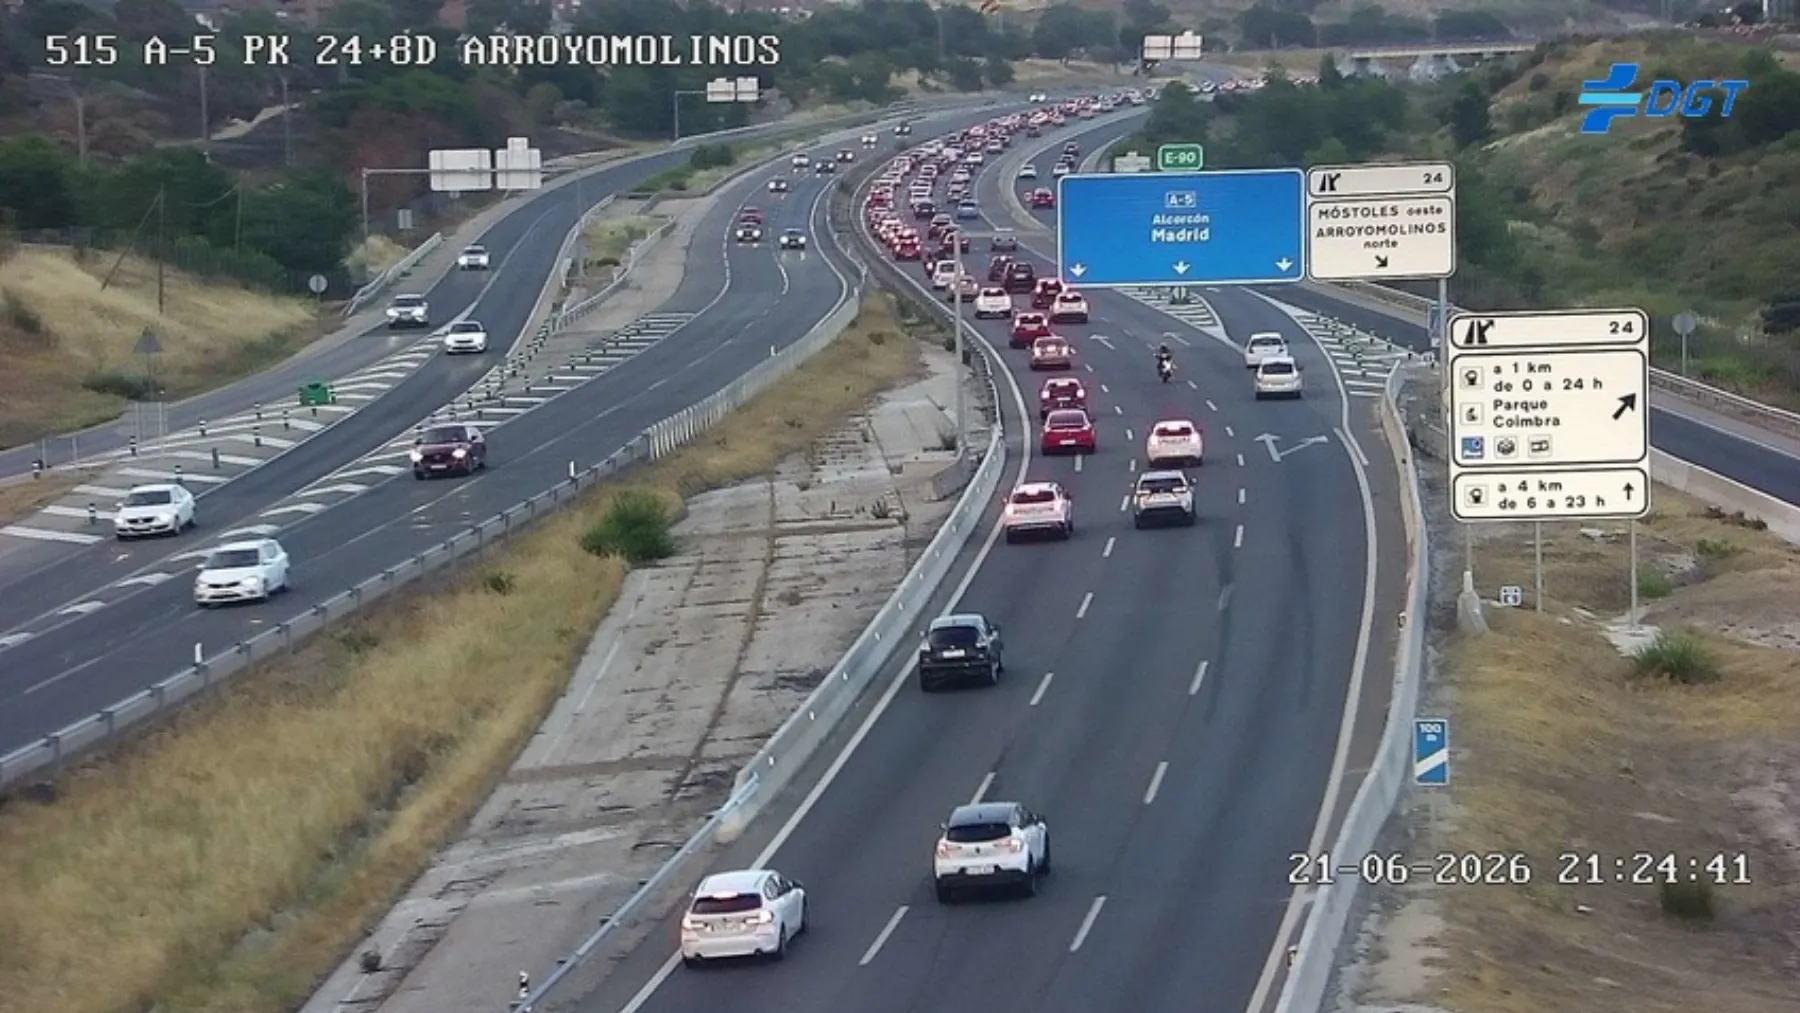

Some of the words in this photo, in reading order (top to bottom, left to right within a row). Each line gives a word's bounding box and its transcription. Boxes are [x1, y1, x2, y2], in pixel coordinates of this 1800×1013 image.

[1165, 152, 1196, 163] E-90
[1423, 173, 1443, 183] 24
[1169, 194, 1193, 205] A-5
[1318, 205, 1399, 219] MÓSTOLES
[1406, 204, 1443, 216] oeste
[1152, 213, 1210, 225] Alcorcón
[1151, 228, 1210, 242] Madrid
[1316, 222, 1447, 238] ARROYOMOLINOS
[1363, 239, 1398, 249] norte
[1609, 321, 1634, 334] 24
[1493, 366, 1502, 374] a
[1512, 362, 1520, 373] 1
[1527, 362, 1552, 373] km
[1493, 381, 1513, 392] de
[1522, 381, 1533, 391] 0
[1543, 381, 1552, 391] a
[1562, 378, 1584, 390] 24
[1593, 378, 1603, 389] h
[1493, 399, 1548, 412] Parque
[1493, 416, 1561, 428] Coimbra
[1497, 483, 1507, 492] a
[1517, 480, 1528, 491] 4
[1538, 480, 1562, 491] km
[1498, 498, 1517, 510] de
[1526, 496, 1536, 508] 6
[1546, 499, 1555, 508] a
[1565, 496, 1586, 508] 23
[1595, 496, 1606, 507] h
[1419, 723, 1441, 733] 100
